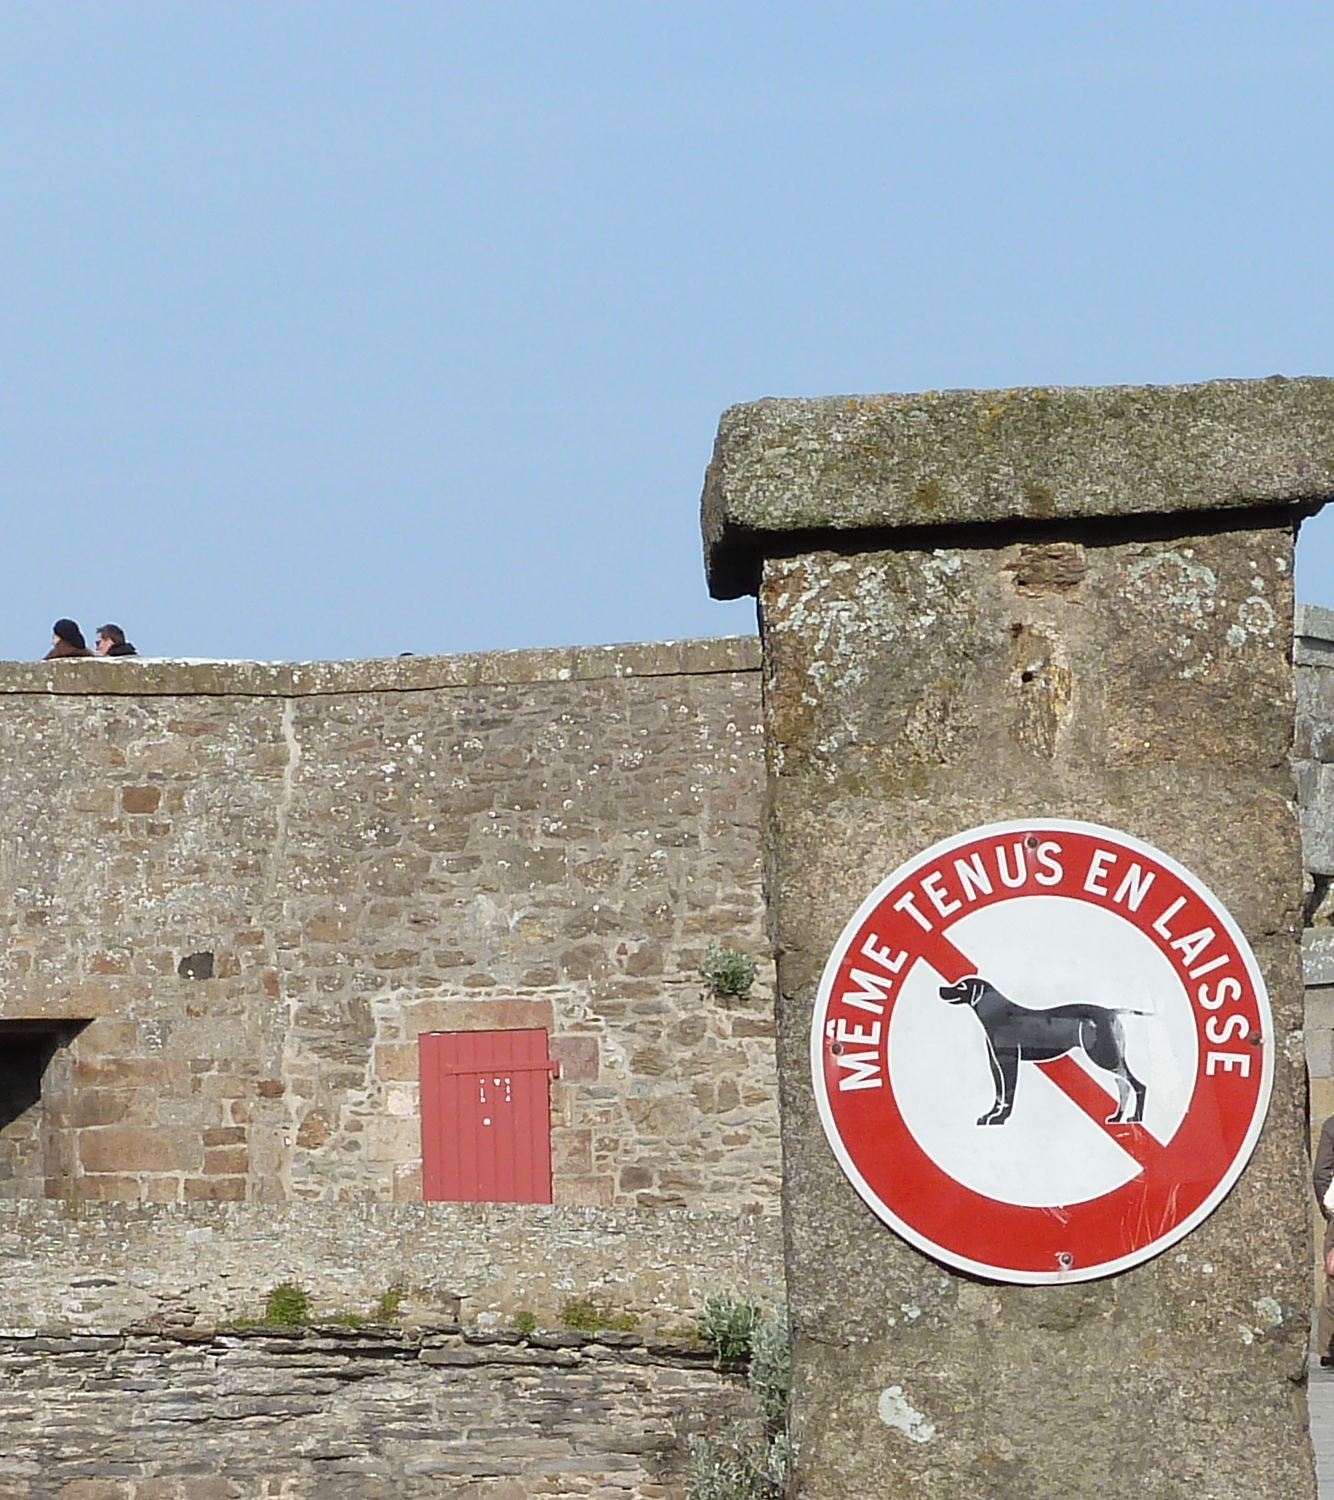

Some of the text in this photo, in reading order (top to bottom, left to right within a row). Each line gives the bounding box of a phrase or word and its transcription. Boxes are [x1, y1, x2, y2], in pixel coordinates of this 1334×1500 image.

[826, 841, 1251, 1091] MÊME TENUS EN LAISSE
